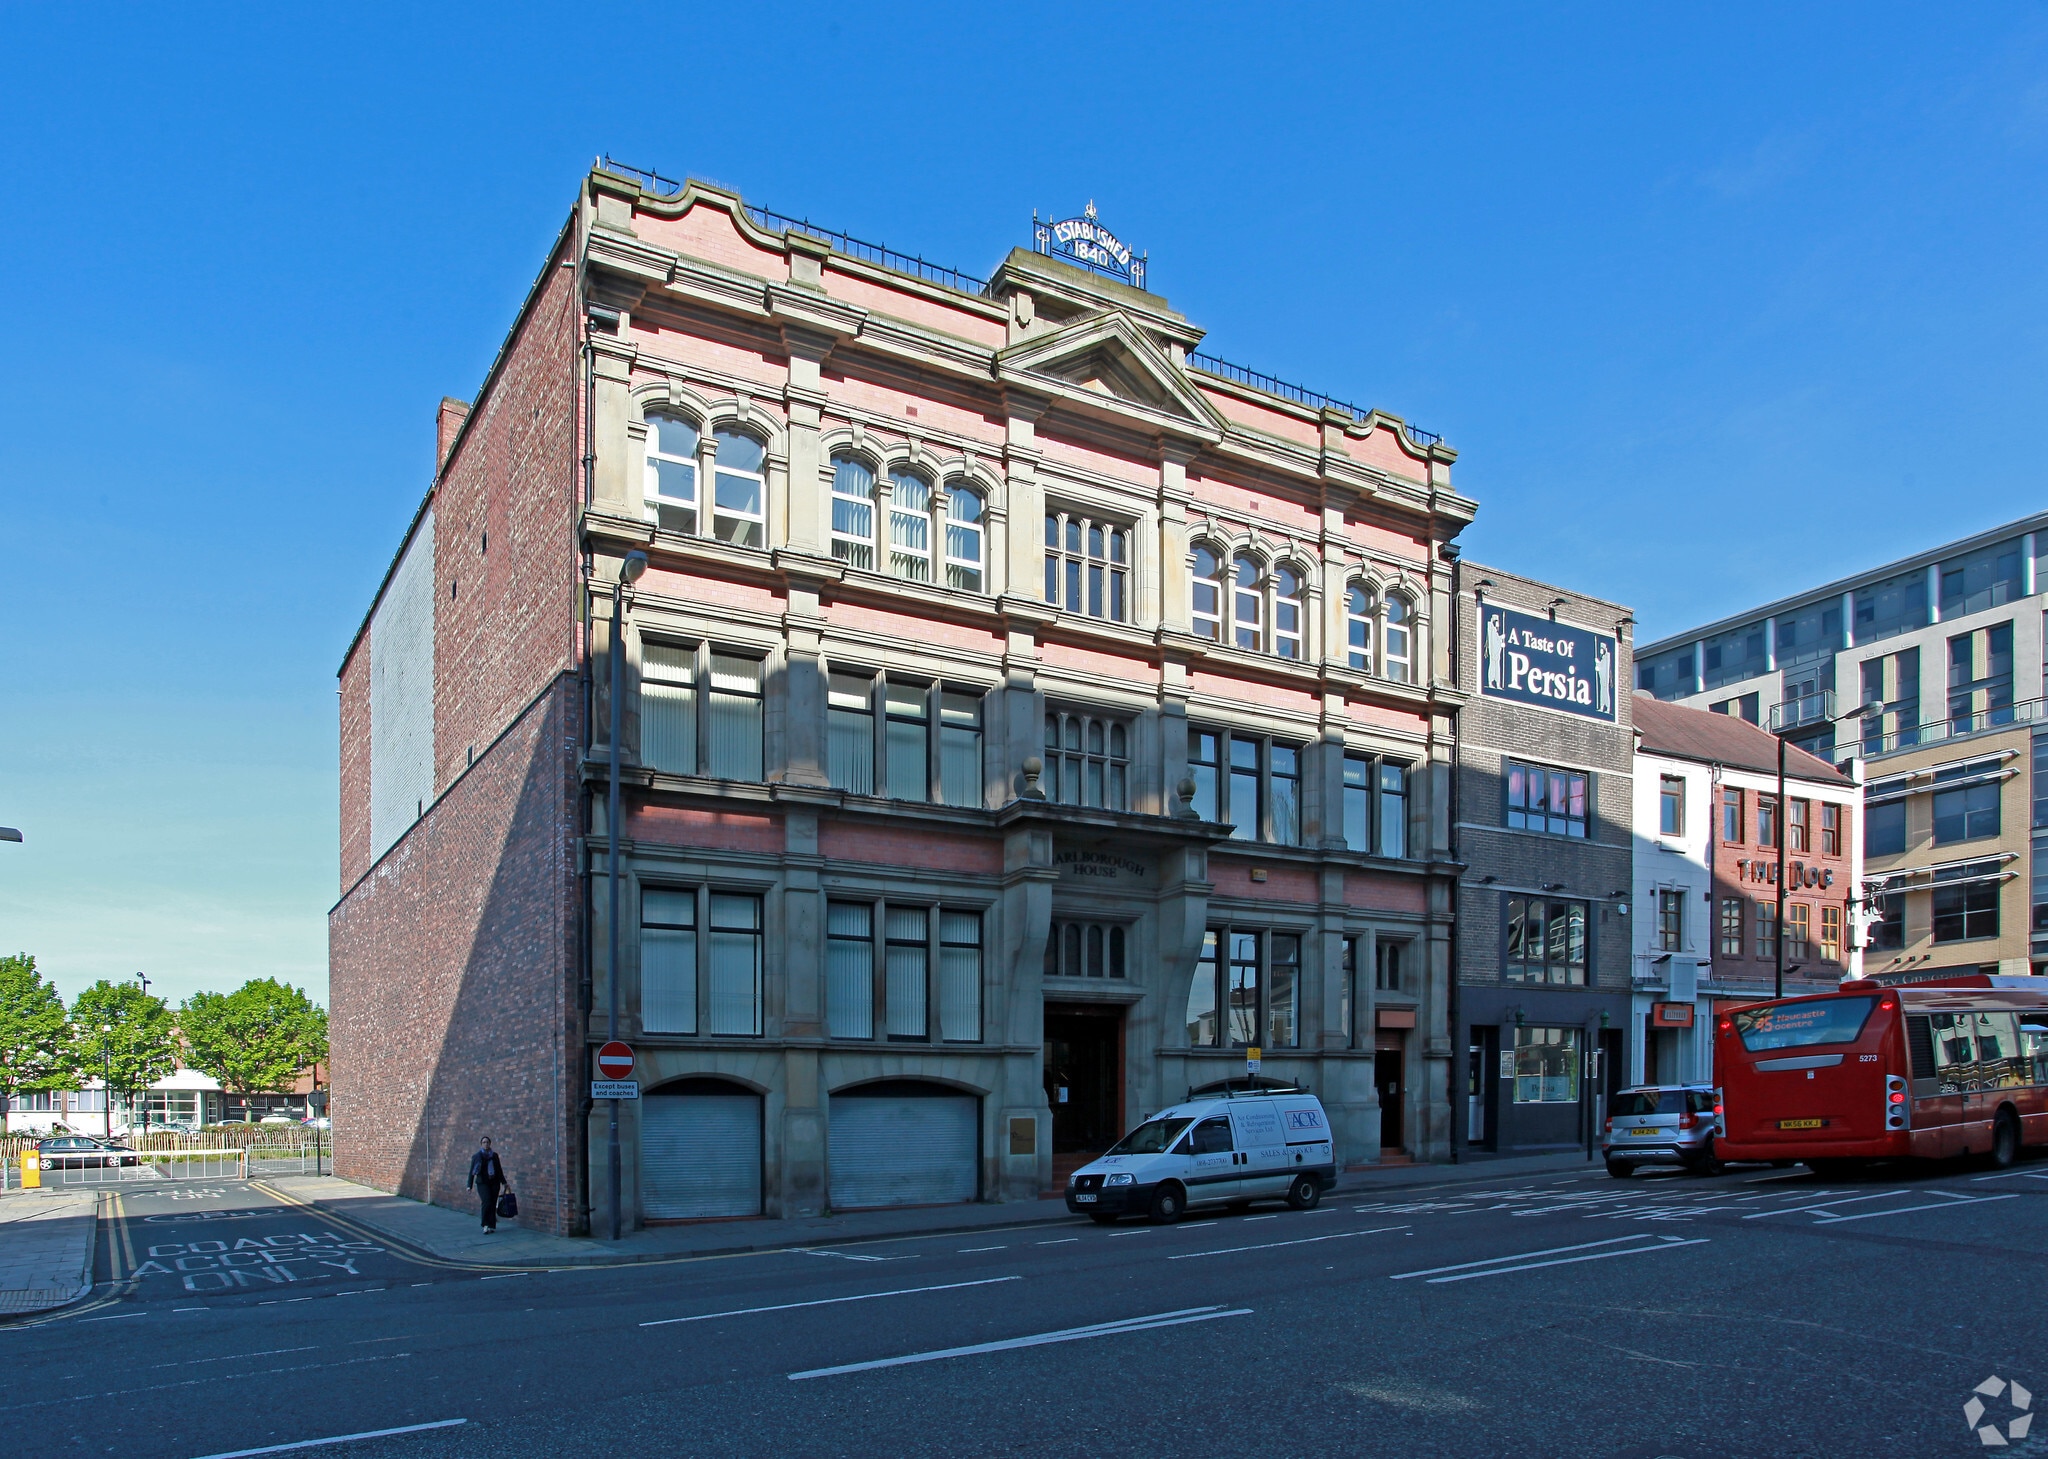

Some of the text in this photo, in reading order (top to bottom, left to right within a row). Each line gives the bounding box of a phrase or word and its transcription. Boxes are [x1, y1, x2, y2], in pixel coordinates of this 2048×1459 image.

[1054, 222, 1130, 265] ESTABLISHED
[1074, 241, 1109, 266] 1840
[1507, 628, 1575, 658] A Taste Of
[1508, 651, 1592, 705] Persia
[1073, 863, 1117, 878] HOUSE
[594, 1083, 615, 1091] Except
[1292, 1111, 1319, 1128] ACR
[1260, 1150, 1281, 1158] SALES
[1289, 1146, 1313, 1155] SERVICE
[148, 1231, 344, 1257] COACH
[130, 1241, 386, 1277] ACCESS
[181, 1258, 360, 1291] ONLY
